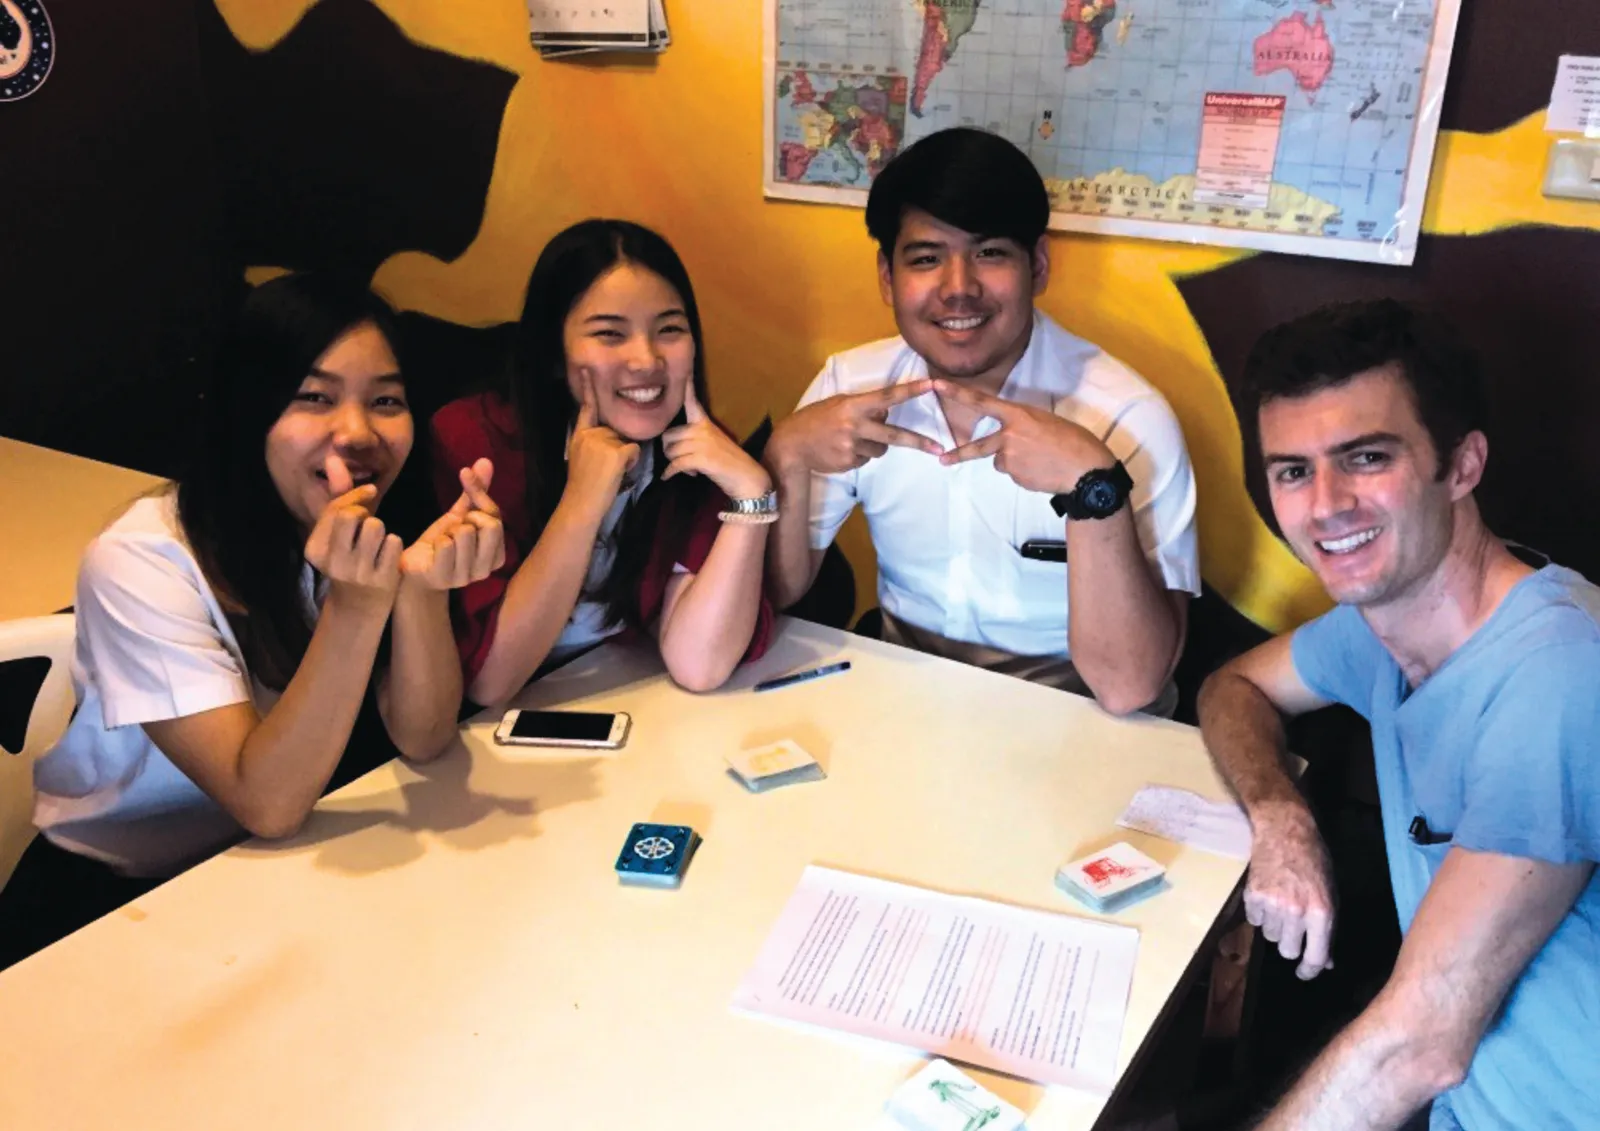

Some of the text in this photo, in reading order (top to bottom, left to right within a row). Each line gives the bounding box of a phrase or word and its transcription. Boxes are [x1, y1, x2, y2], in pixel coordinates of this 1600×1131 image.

[1257, 50, 1332, 61] AUSTRALIA
[1043, 110, 1052, 120] N
[1067, 181, 1188, 199] ANTARCTICA
